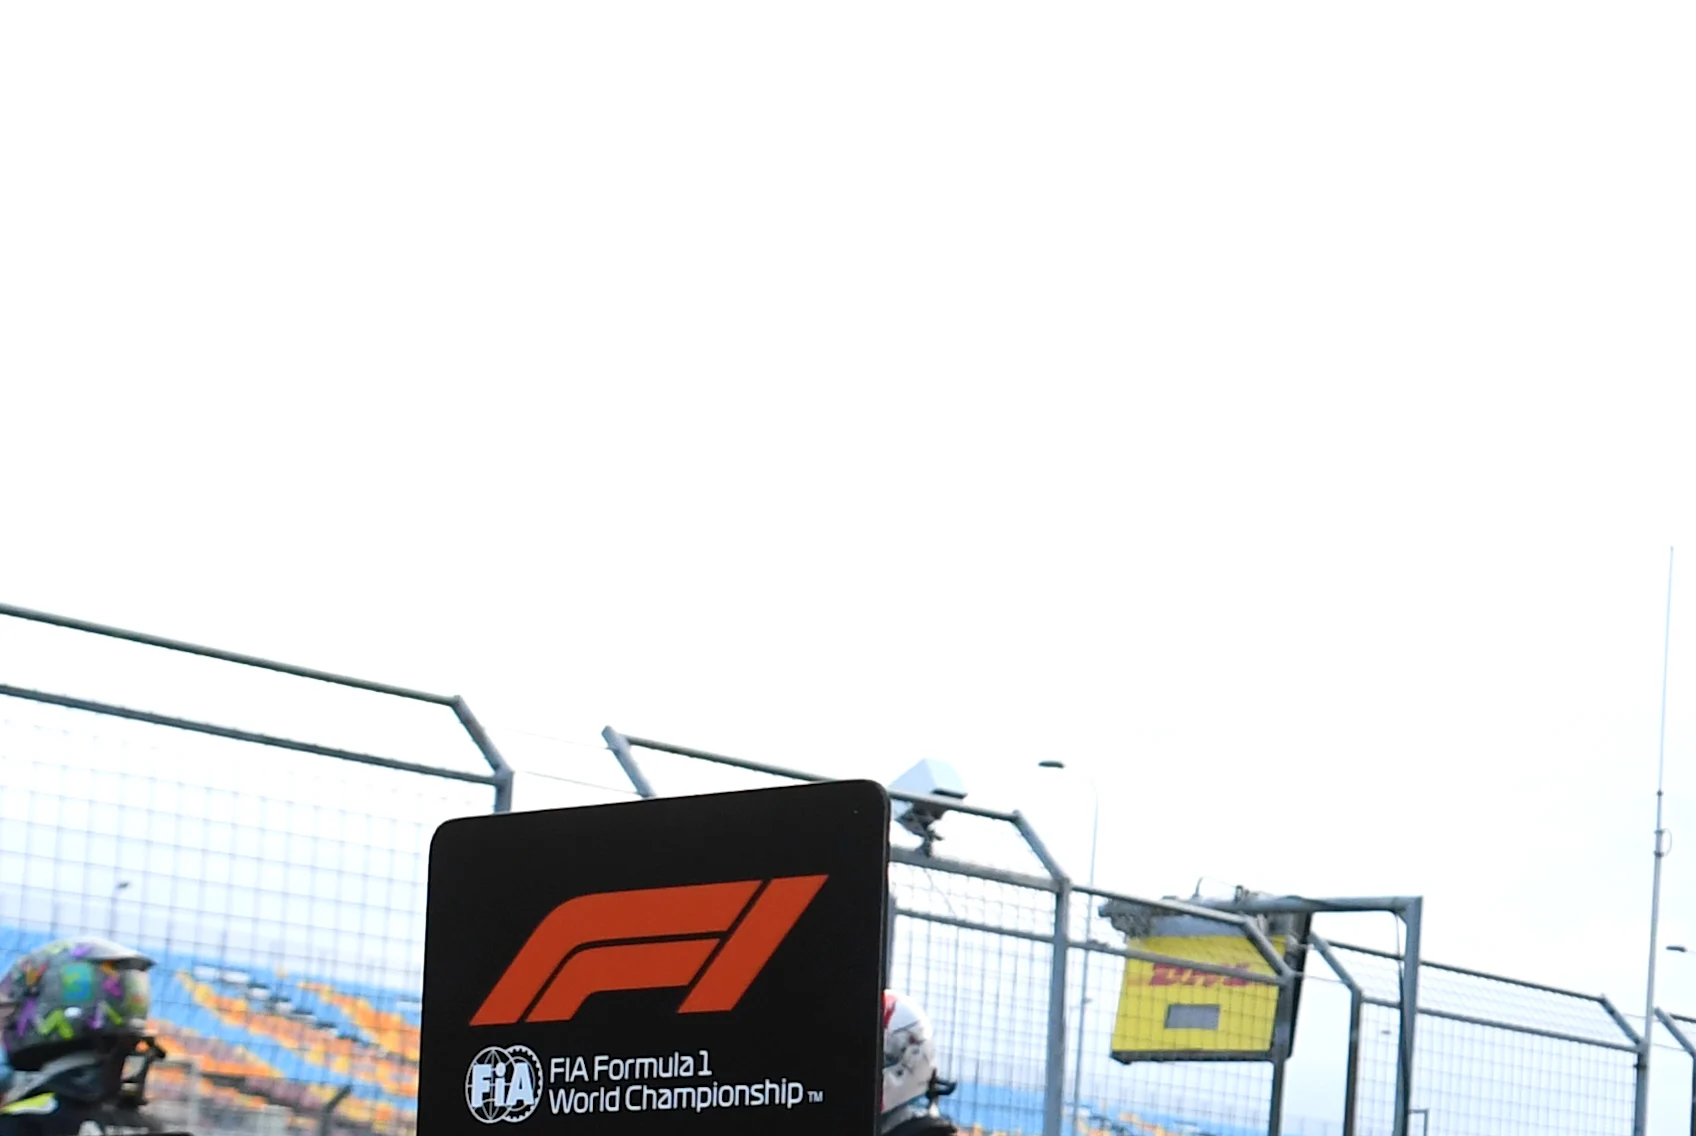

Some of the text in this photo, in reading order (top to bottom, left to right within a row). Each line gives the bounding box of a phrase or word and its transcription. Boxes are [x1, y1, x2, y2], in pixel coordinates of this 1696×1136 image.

[550, 1050, 712, 1083] FIA Formula 1
[548, 1087, 619, 1115] World
